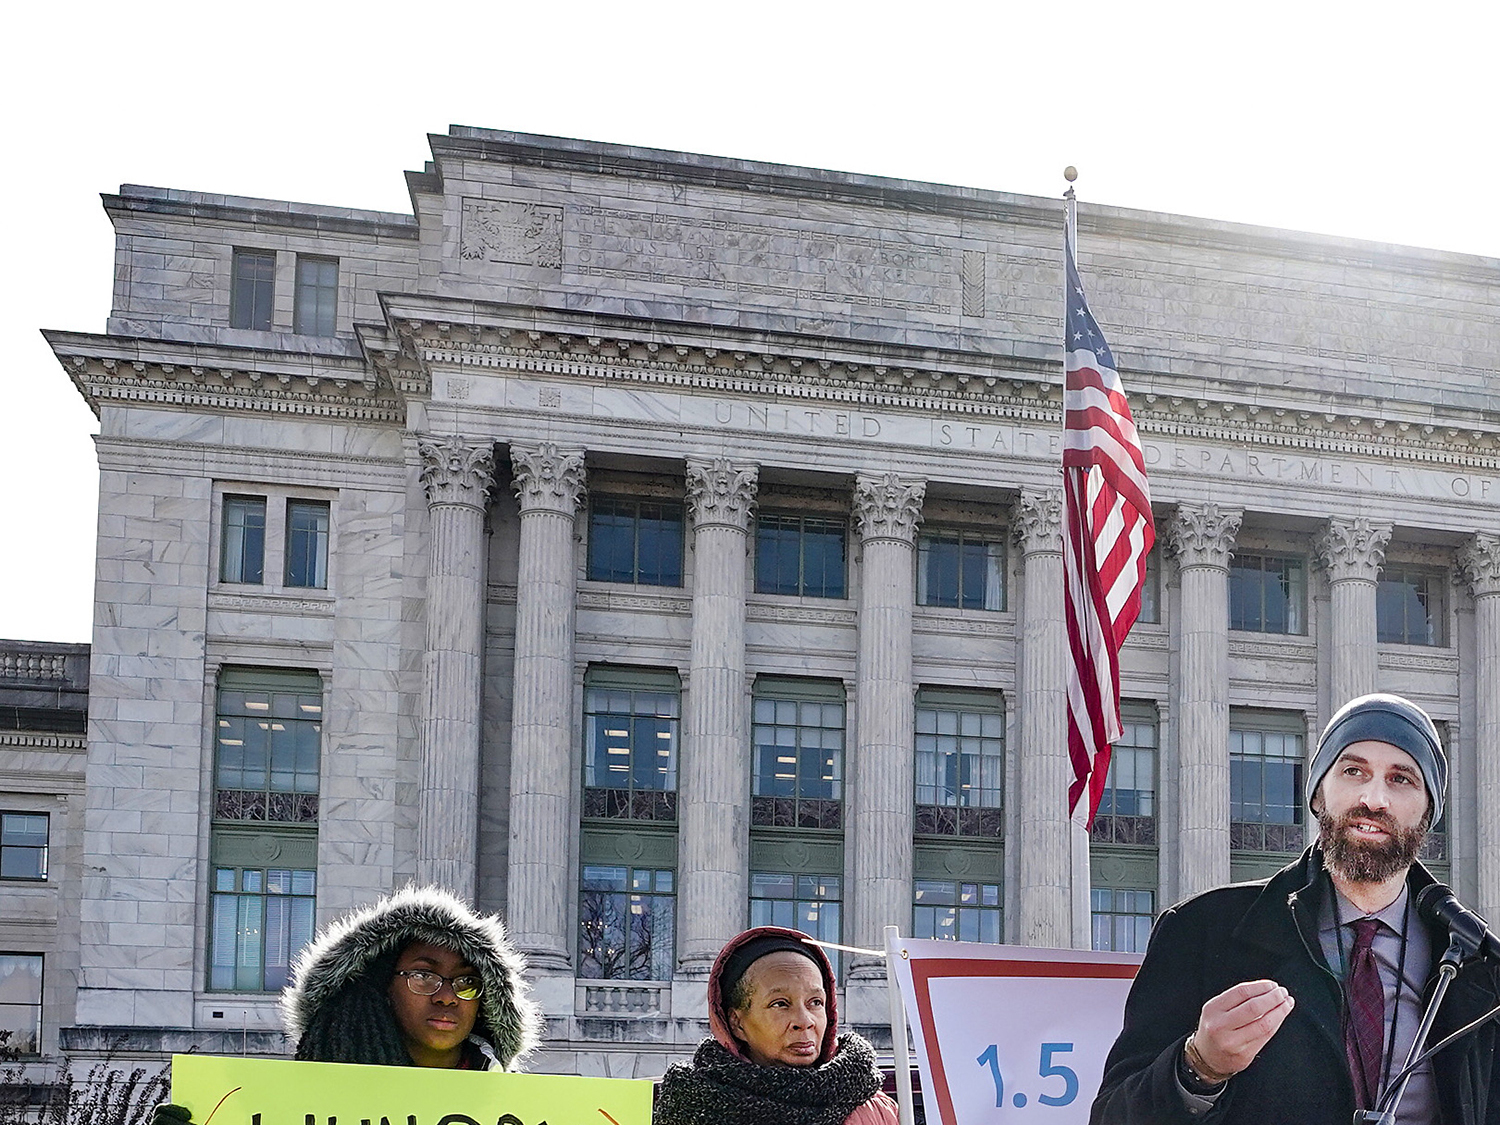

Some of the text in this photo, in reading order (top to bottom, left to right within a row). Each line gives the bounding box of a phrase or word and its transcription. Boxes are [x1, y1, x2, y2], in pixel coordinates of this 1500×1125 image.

[715, 402, 881, 438] UNITED
[940, 424, 1062, 455] STATE
[1144, 445, 1402, 490] DEPARTMENT
[1452, 477, 1492, 499] OF
[976, 1043, 1079, 1108] 1.5
